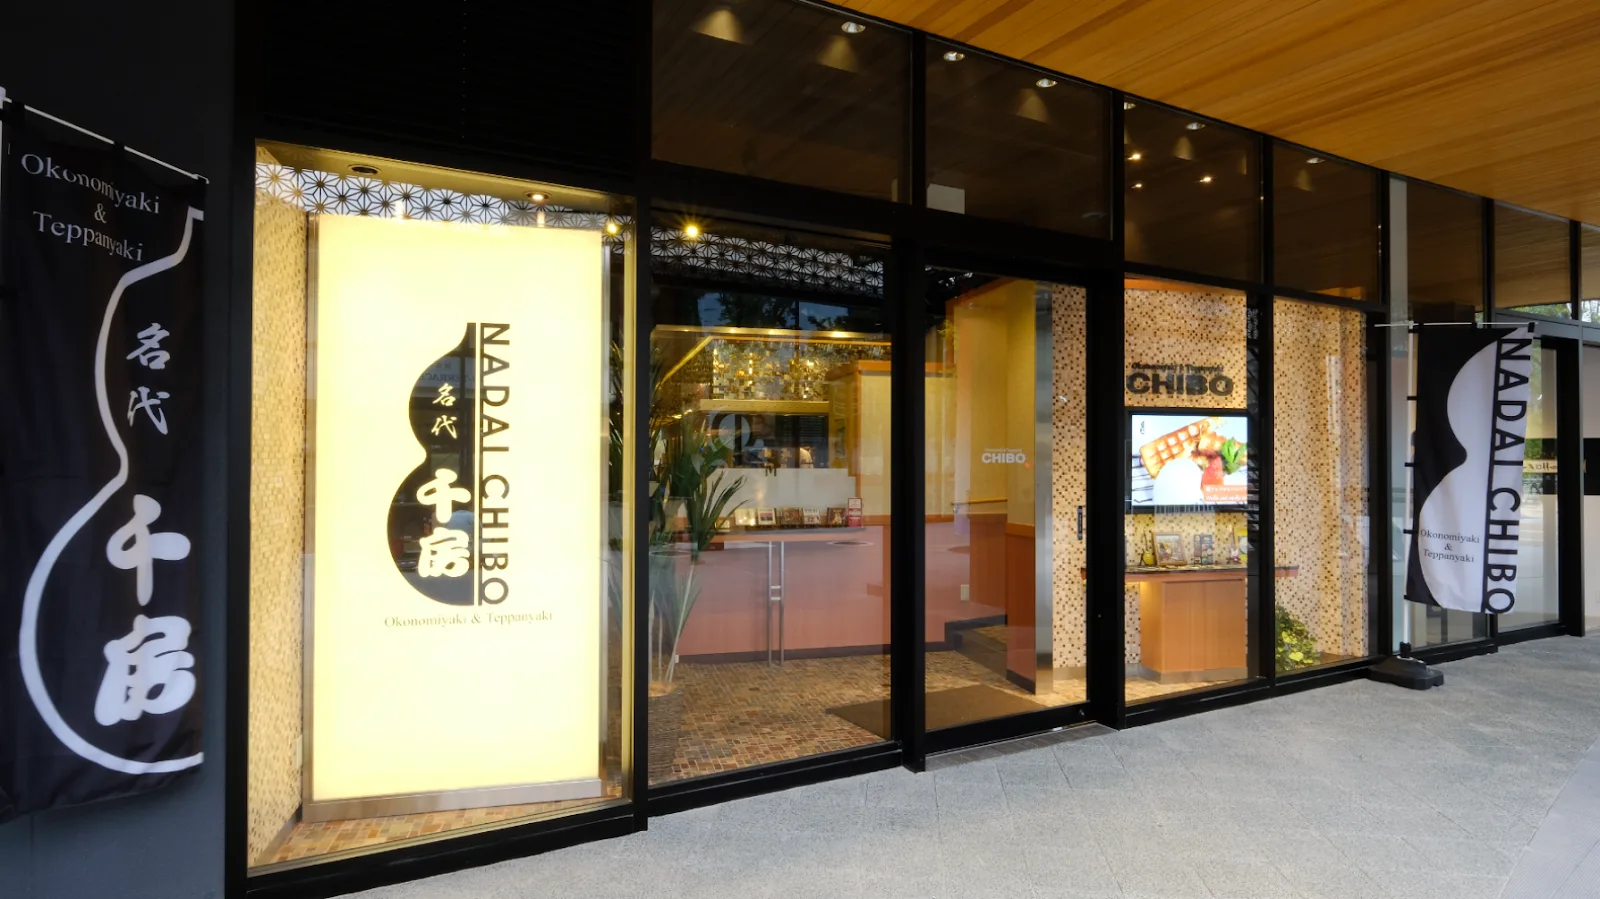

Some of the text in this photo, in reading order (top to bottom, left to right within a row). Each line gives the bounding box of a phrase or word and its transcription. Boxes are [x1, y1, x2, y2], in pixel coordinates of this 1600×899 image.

[21, 153, 160, 214] Okonomiyaki
[33, 211, 143, 262] Teppanyaki
[94, 202, 107, 224] &
[126, 322, 170, 435] 名代
[1126, 372, 1234, 396] CHIBO
[431, 383, 458, 439] 名代
[982, 453, 1026, 464] CHIBO
[416, 468, 471, 578] 千房
[480, 474, 510, 605] CHIBO
[1420, 528, 1480, 544] Okonomiyaki
[1444, 543, 1452, 551] &
[1423, 549, 1475, 563] Teppanyaki
[1484, 487, 1521, 615] CHIBO
[94, 494, 196, 726] 千房
[384, 610, 552, 628] Okonomiyaki & Teppanyaki
